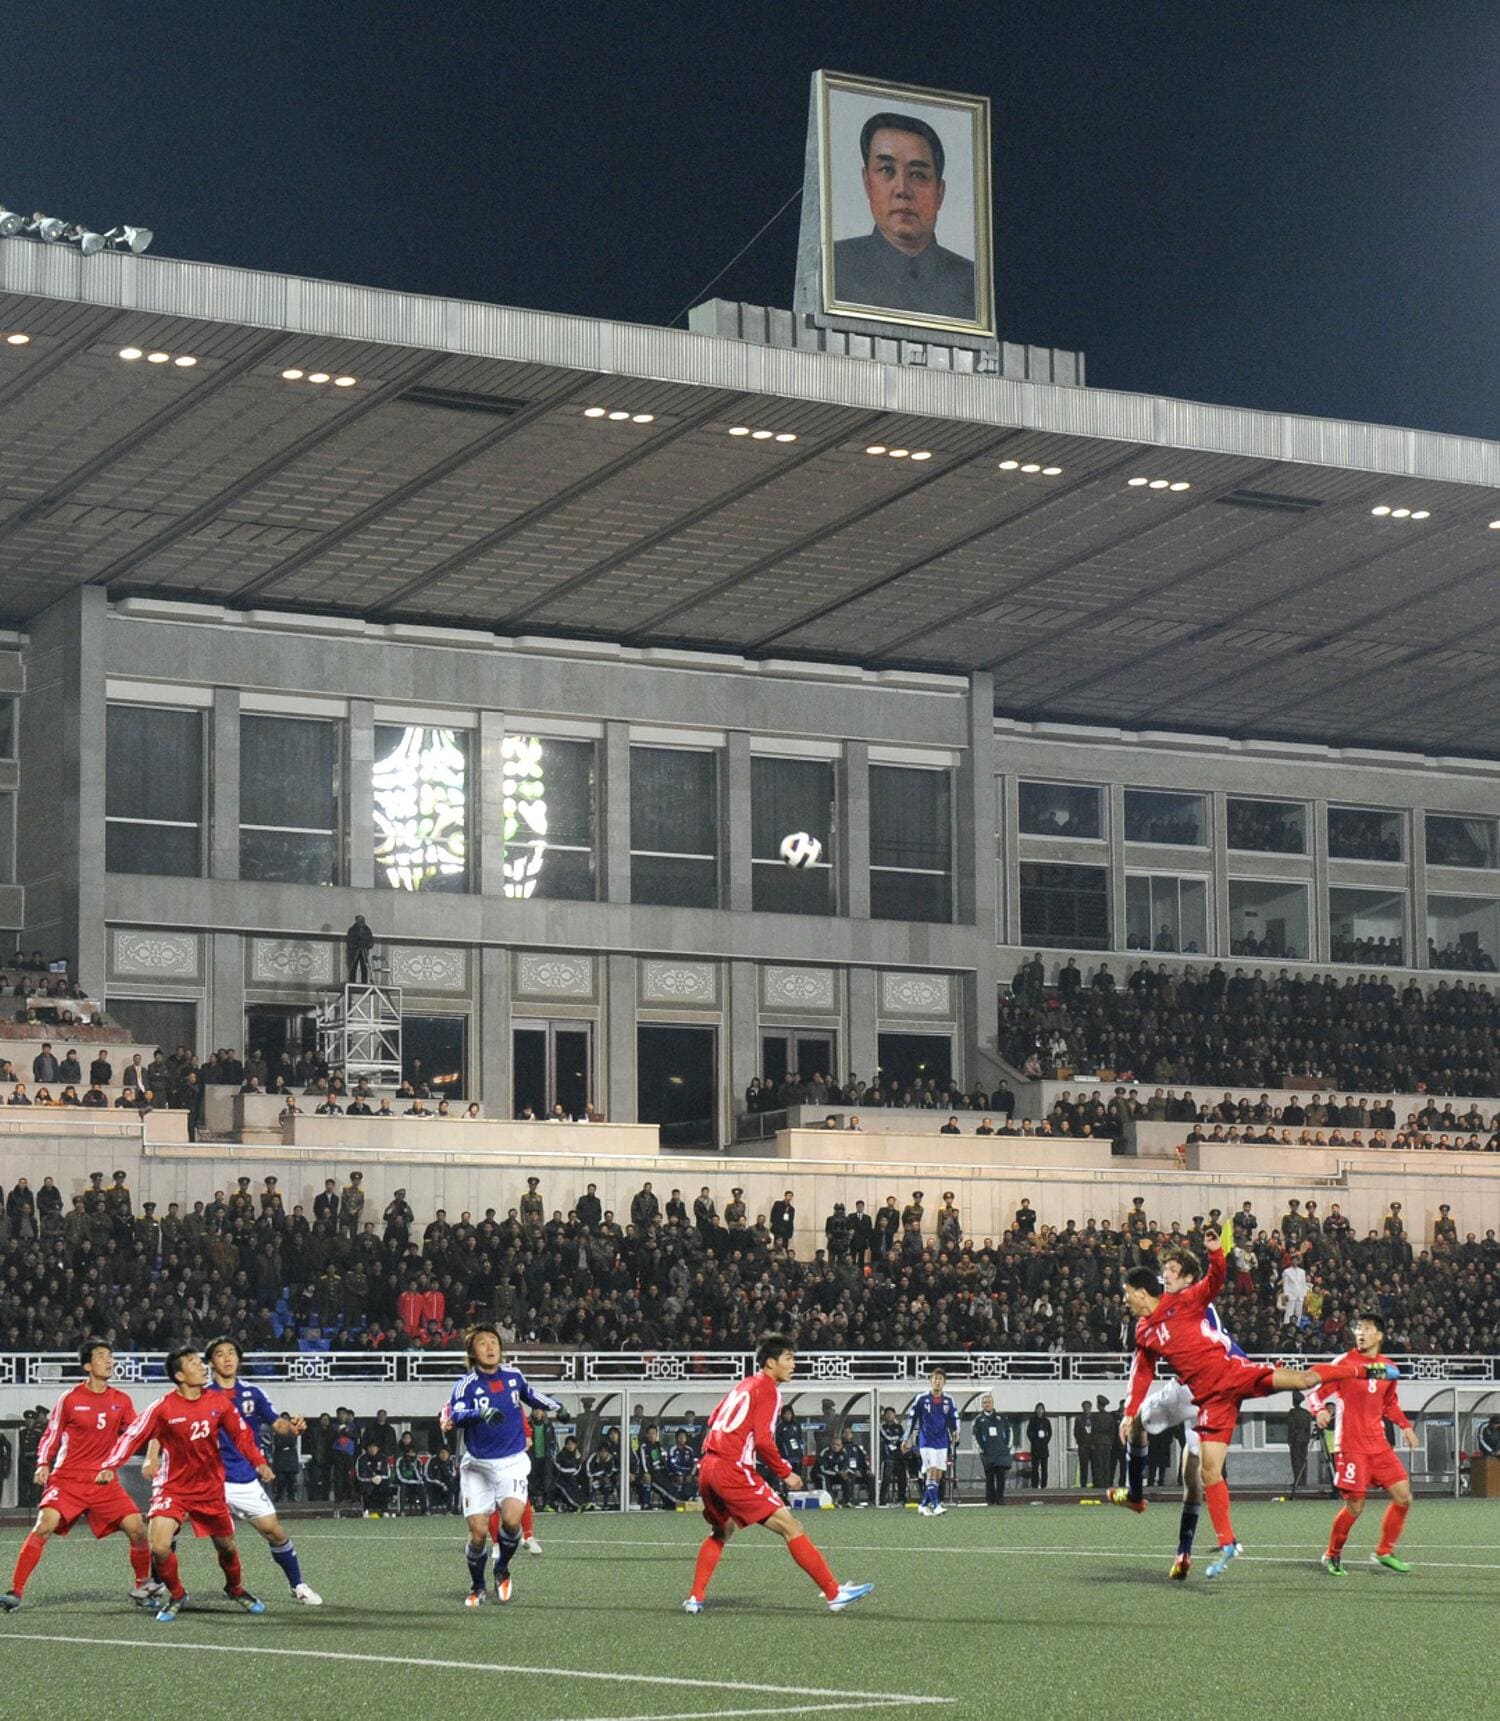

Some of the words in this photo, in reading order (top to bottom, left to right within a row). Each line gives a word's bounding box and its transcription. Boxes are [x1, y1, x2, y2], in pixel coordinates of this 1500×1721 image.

[1156, 1322, 1171, 1346] 14
[924, 1404, 931, 1413] 4
[97, 1413, 106, 1429] 5
[190, 1420, 211, 1440] 23
[1345, 1462, 1356, 1479] 8
[513, 1479, 526, 1494] 19
